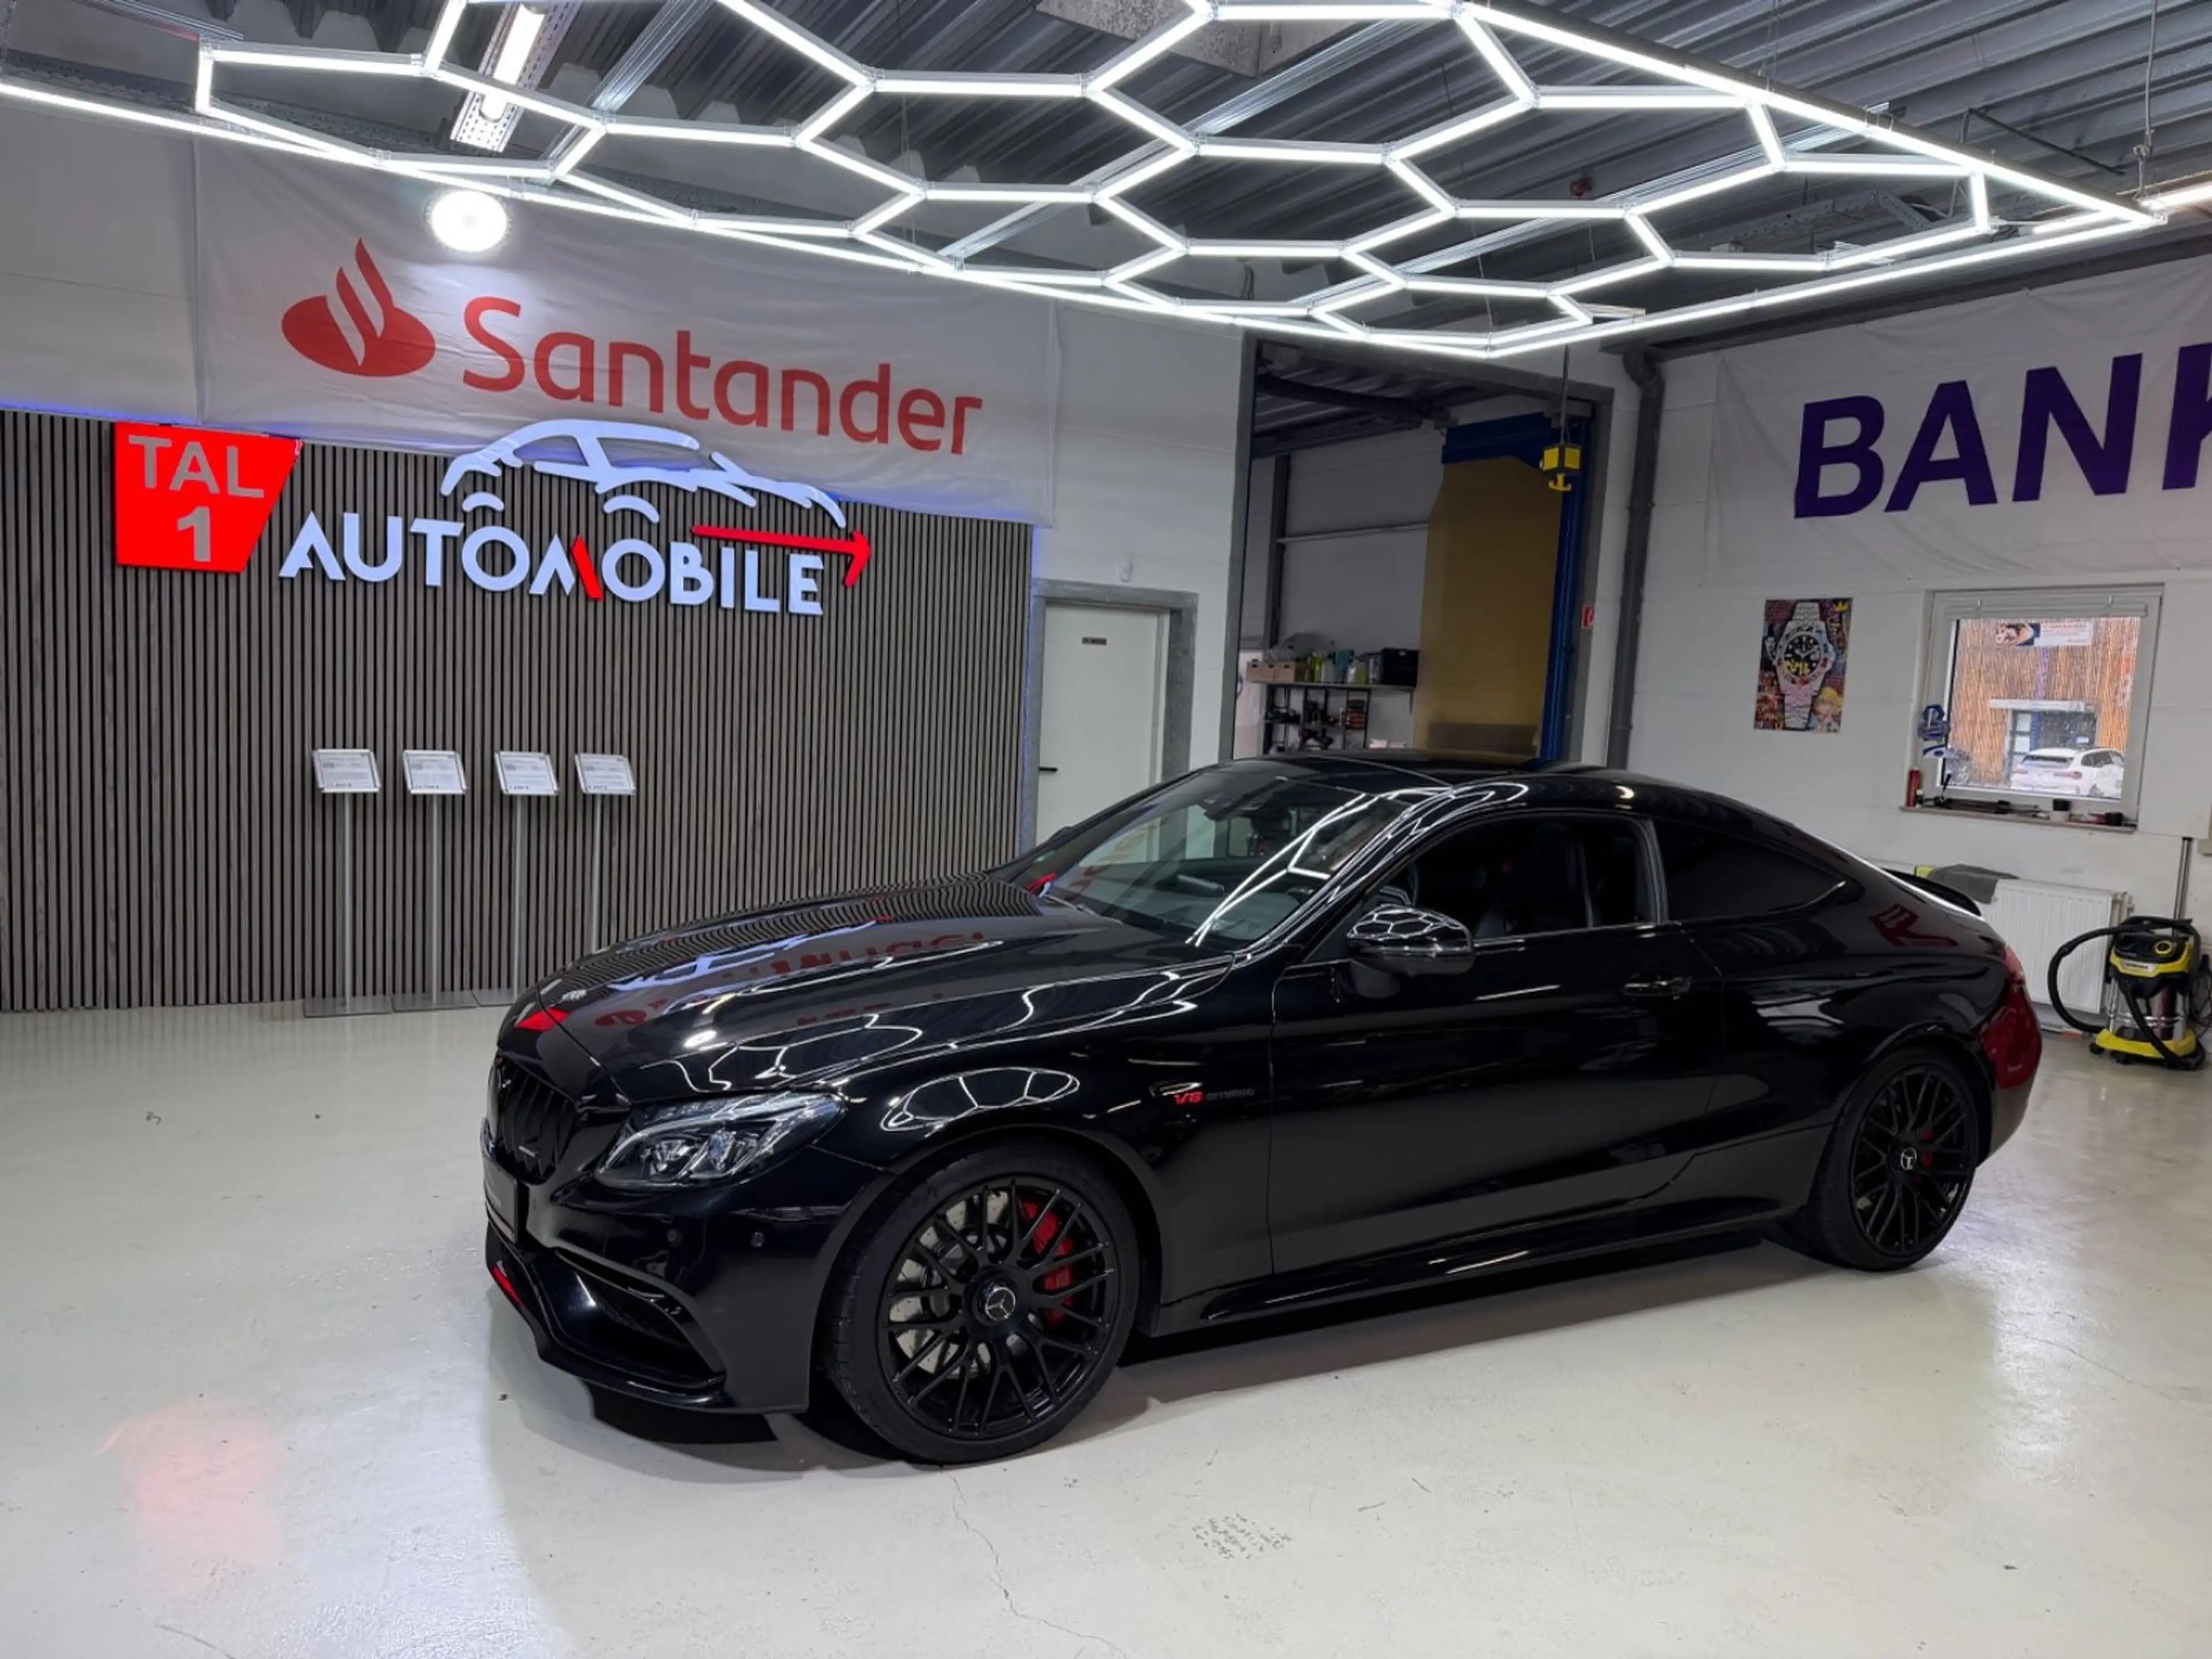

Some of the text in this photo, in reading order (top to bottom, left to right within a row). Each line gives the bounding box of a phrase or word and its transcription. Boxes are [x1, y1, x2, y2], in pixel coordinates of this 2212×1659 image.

[463, 296, 983, 456] Santander
[128, 434, 265, 498] TAL
[177, 506, 211, 562] 1
[278, 510, 825, 616] AUTOMOBILE
